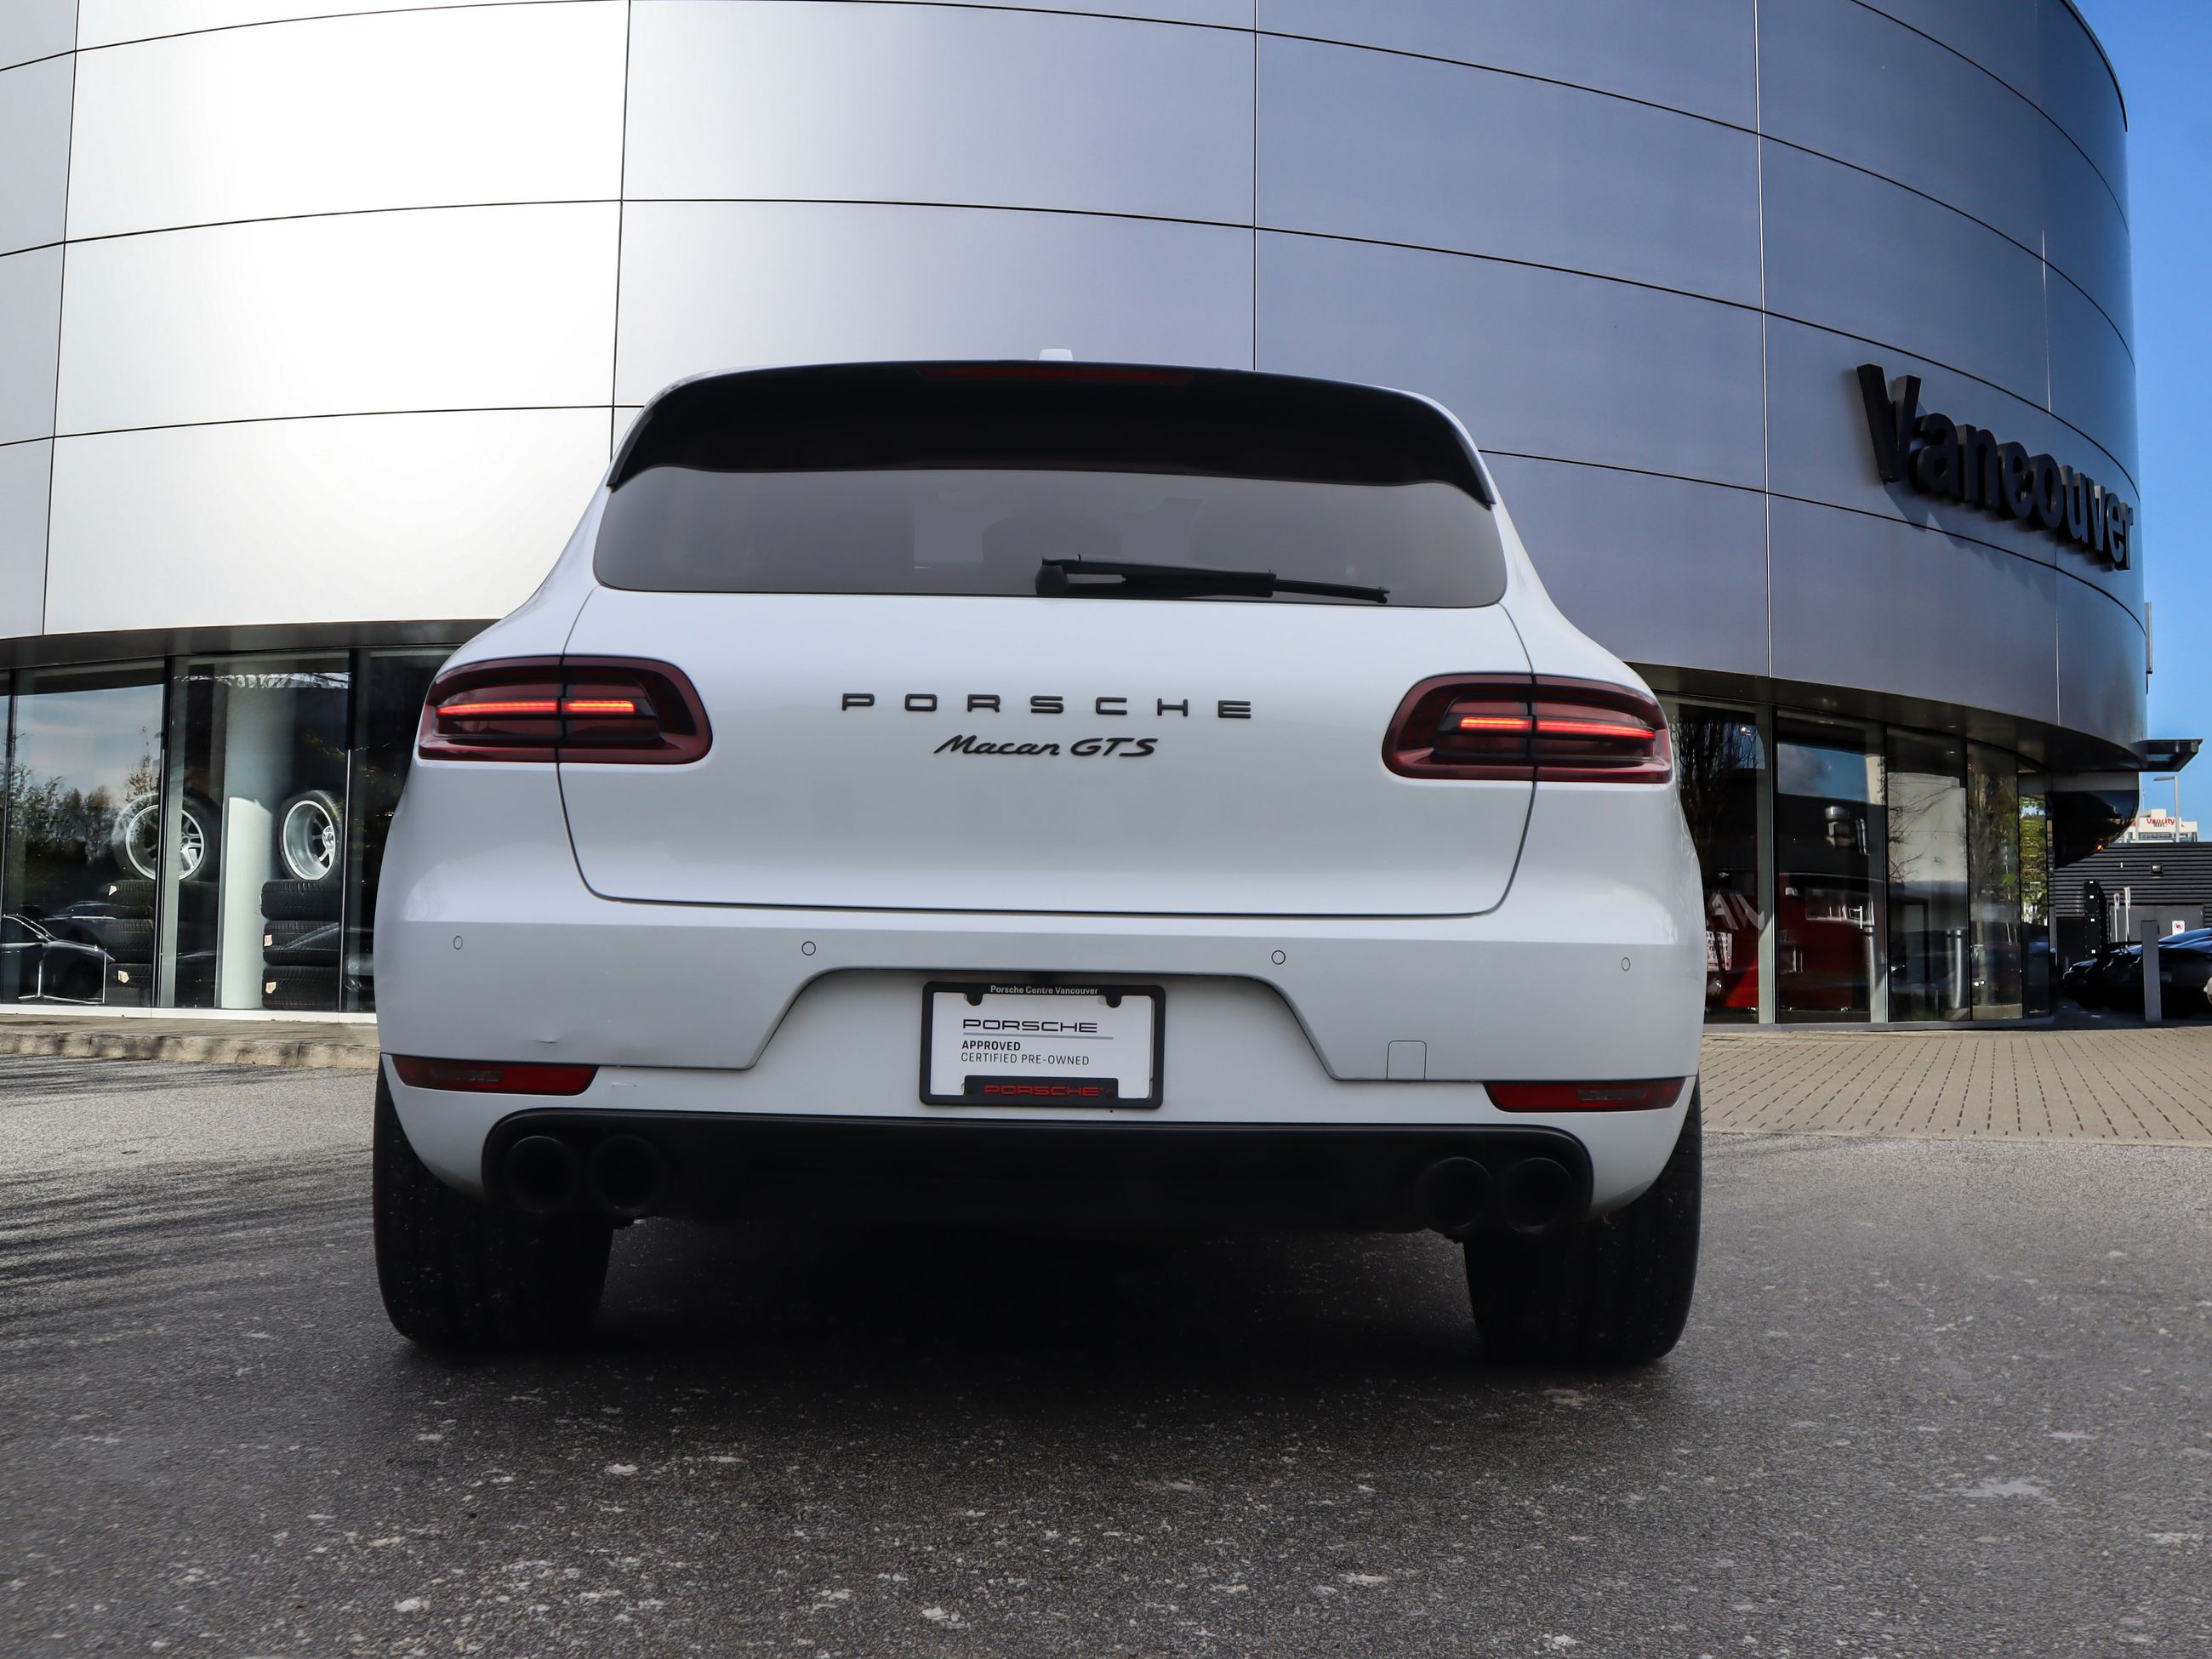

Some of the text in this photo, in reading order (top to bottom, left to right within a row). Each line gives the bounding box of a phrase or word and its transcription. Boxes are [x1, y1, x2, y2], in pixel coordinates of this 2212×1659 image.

[1857, 363, 2133, 571] Vancouver
[841, 693, 1251, 719] PORSCHE
[933, 734, 1158, 756] Macan GTS
[990, 984, 1098, 995] Porsche Centre Vancouver
[963, 1018, 1097, 1033] PORSCHE
[961, 1040, 1021, 1051] APPROVED
[961, 1052, 1090, 1065] CERTIFIED PRE-OWNED
